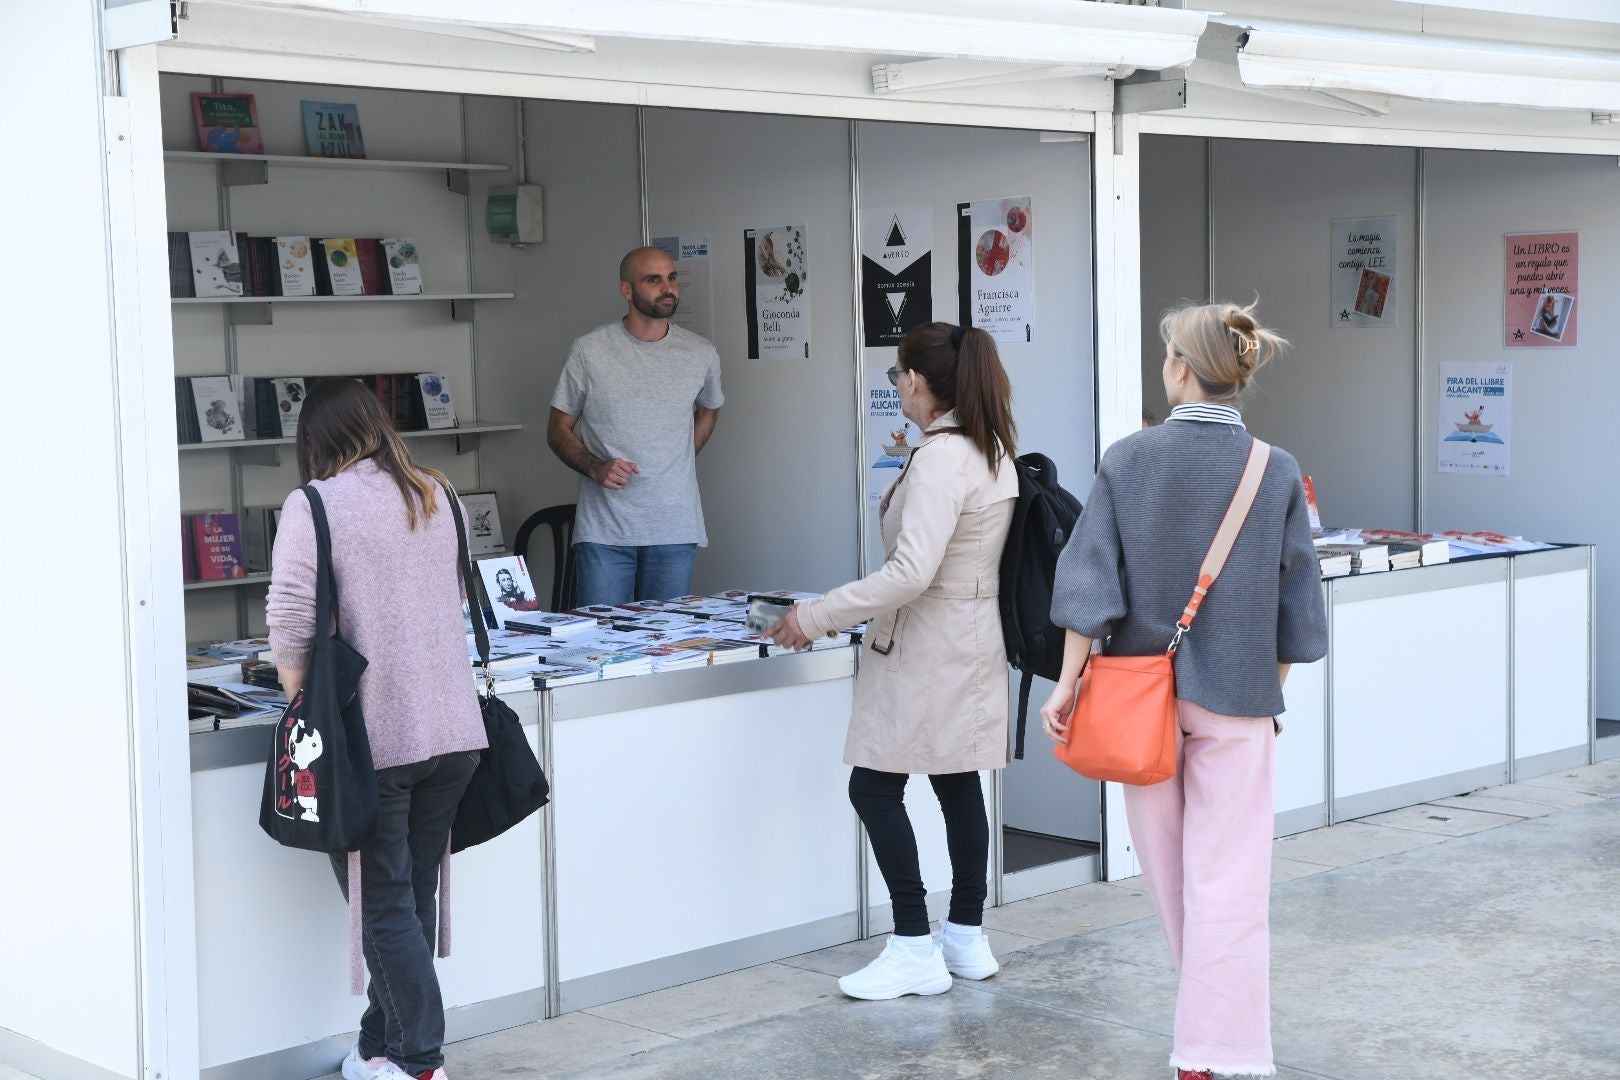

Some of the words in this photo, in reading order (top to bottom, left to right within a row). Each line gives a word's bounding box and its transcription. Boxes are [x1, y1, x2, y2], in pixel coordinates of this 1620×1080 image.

[315, 112, 347, 131] ZAK
[1348, 232, 1359, 243] La
[1359, 233, 1382, 245] magia
[1347, 247, 1381, 255] comienza
[1513, 245, 1526, 255] Un
[1527, 243, 1560, 254] LIBRO
[1562, 245, 1570, 253] es
[1368, 256, 1387, 267] LEE
[1527, 257, 1552, 271] regalo
[1554, 260, 1568, 270] que
[1516, 272, 1543, 285] puedes
[1546, 271, 1565, 280] abrir
[977, 288, 1019, 300] Francisca
[762, 307, 800, 319] Gioconda
[977, 303, 1012, 316] Aguirre
[1446, 377, 1463, 385] FIRA
[1465, 378, 1479, 386] DEL
[1480, 378, 1504, 386] LLIBRE
[871, 389, 891, 399] FERIA
[1446, 386, 1482, 394] ALACANT
[204, 534, 235, 543] MUJER
[211, 554, 232, 563] VIDA
